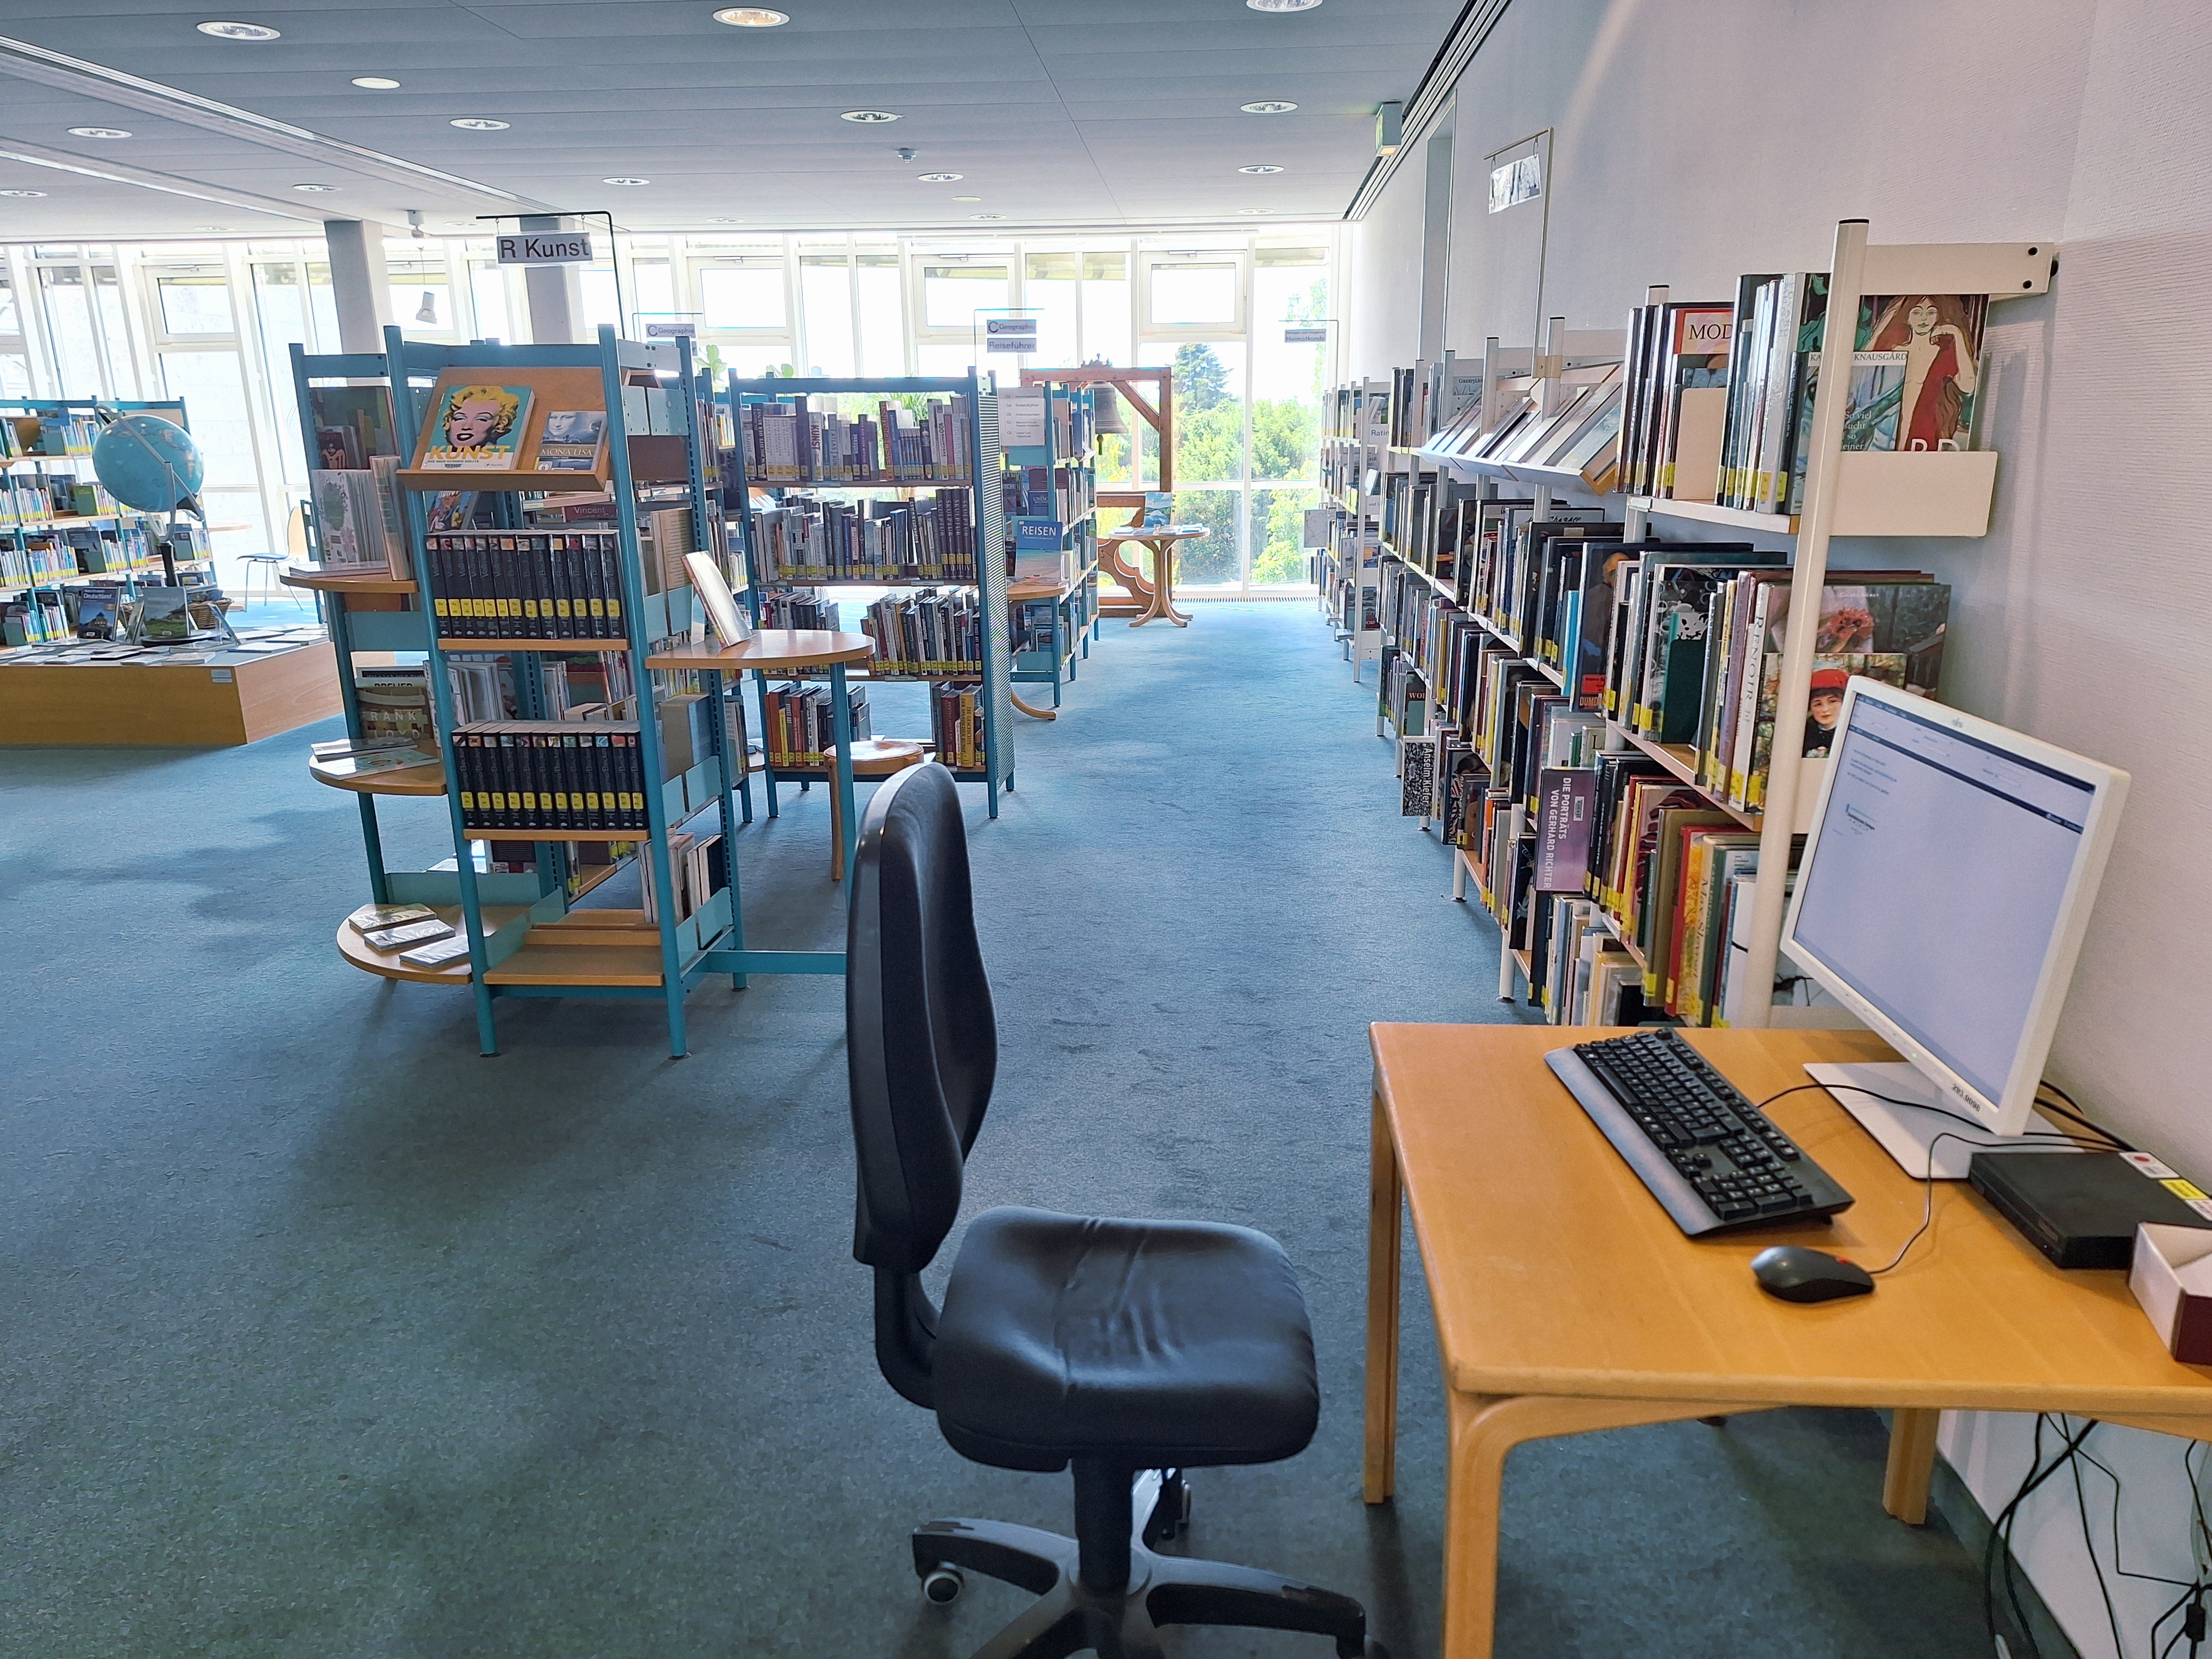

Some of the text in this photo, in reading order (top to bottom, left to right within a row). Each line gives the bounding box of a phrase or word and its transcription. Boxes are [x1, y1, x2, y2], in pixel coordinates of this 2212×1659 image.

[500, 238, 589, 259] R Kunst
[647, 325, 658, 336] C
[989, 321, 999, 333] C
[1688, 324, 1733, 340] MOD
[811, 425, 821, 451] KUNST
[429, 445, 511, 460] KUNST
[1022, 526, 1056, 536] REISEN
[1745, 616, 1764, 700] RENOIR
[1580, 697, 1598, 706] DUMO
[371, 712, 416, 721] RANK
[1422, 747, 1433, 805] Anselm Kiefer
[1559, 777, 1572, 839] DIE PORTRÄTS
[1544, 789, 1560, 889] VON GERHARD RICHTER
